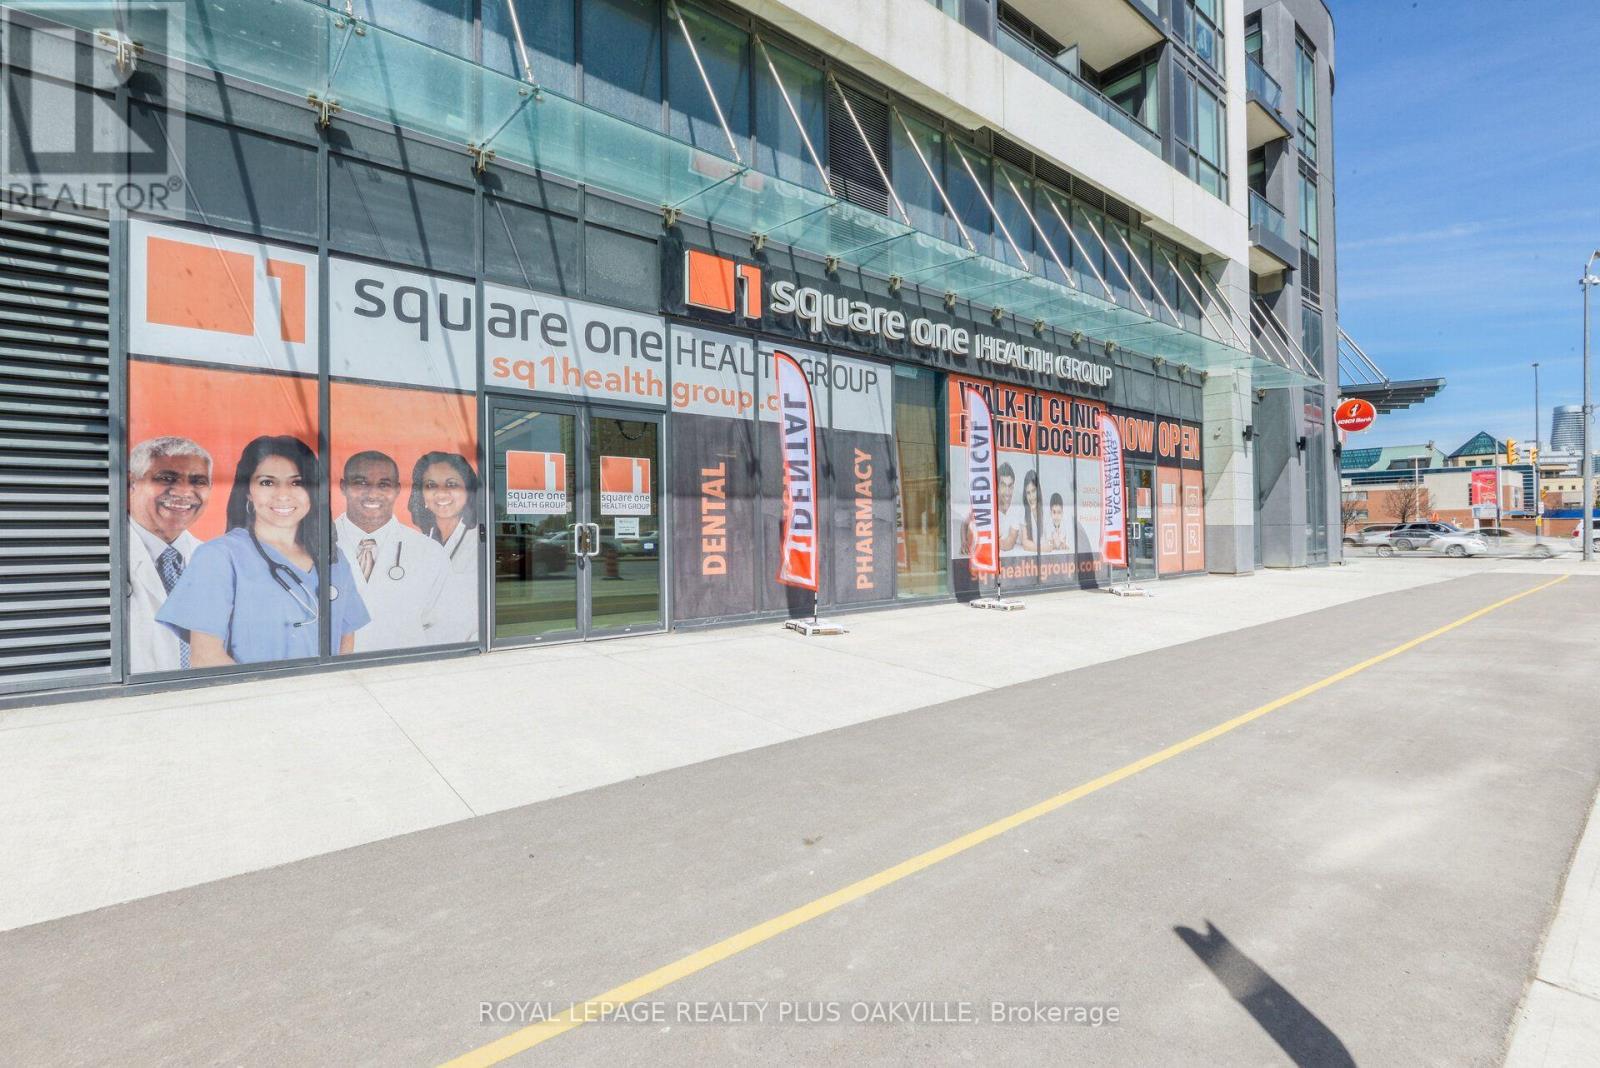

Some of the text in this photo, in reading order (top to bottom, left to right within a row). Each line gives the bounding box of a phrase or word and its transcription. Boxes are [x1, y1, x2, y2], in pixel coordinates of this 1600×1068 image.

[353, 277, 878, 394] square one HEALT GROUP
[770, 280, 906, 341] square
[910, 317, 970, 355] one
[974, 333, 1054, 375] HEALTH
[1055, 355, 1113, 387] GROUP
[1050, 398, 1100, 431] CLINIC
[1158, 421, 1200, 460] OPEN
[507, 492, 545, 503] square
[601, 494, 633, 504] square
[701, 462, 727, 576] DENTAL
[854, 447, 874, 590] PHARMACY
